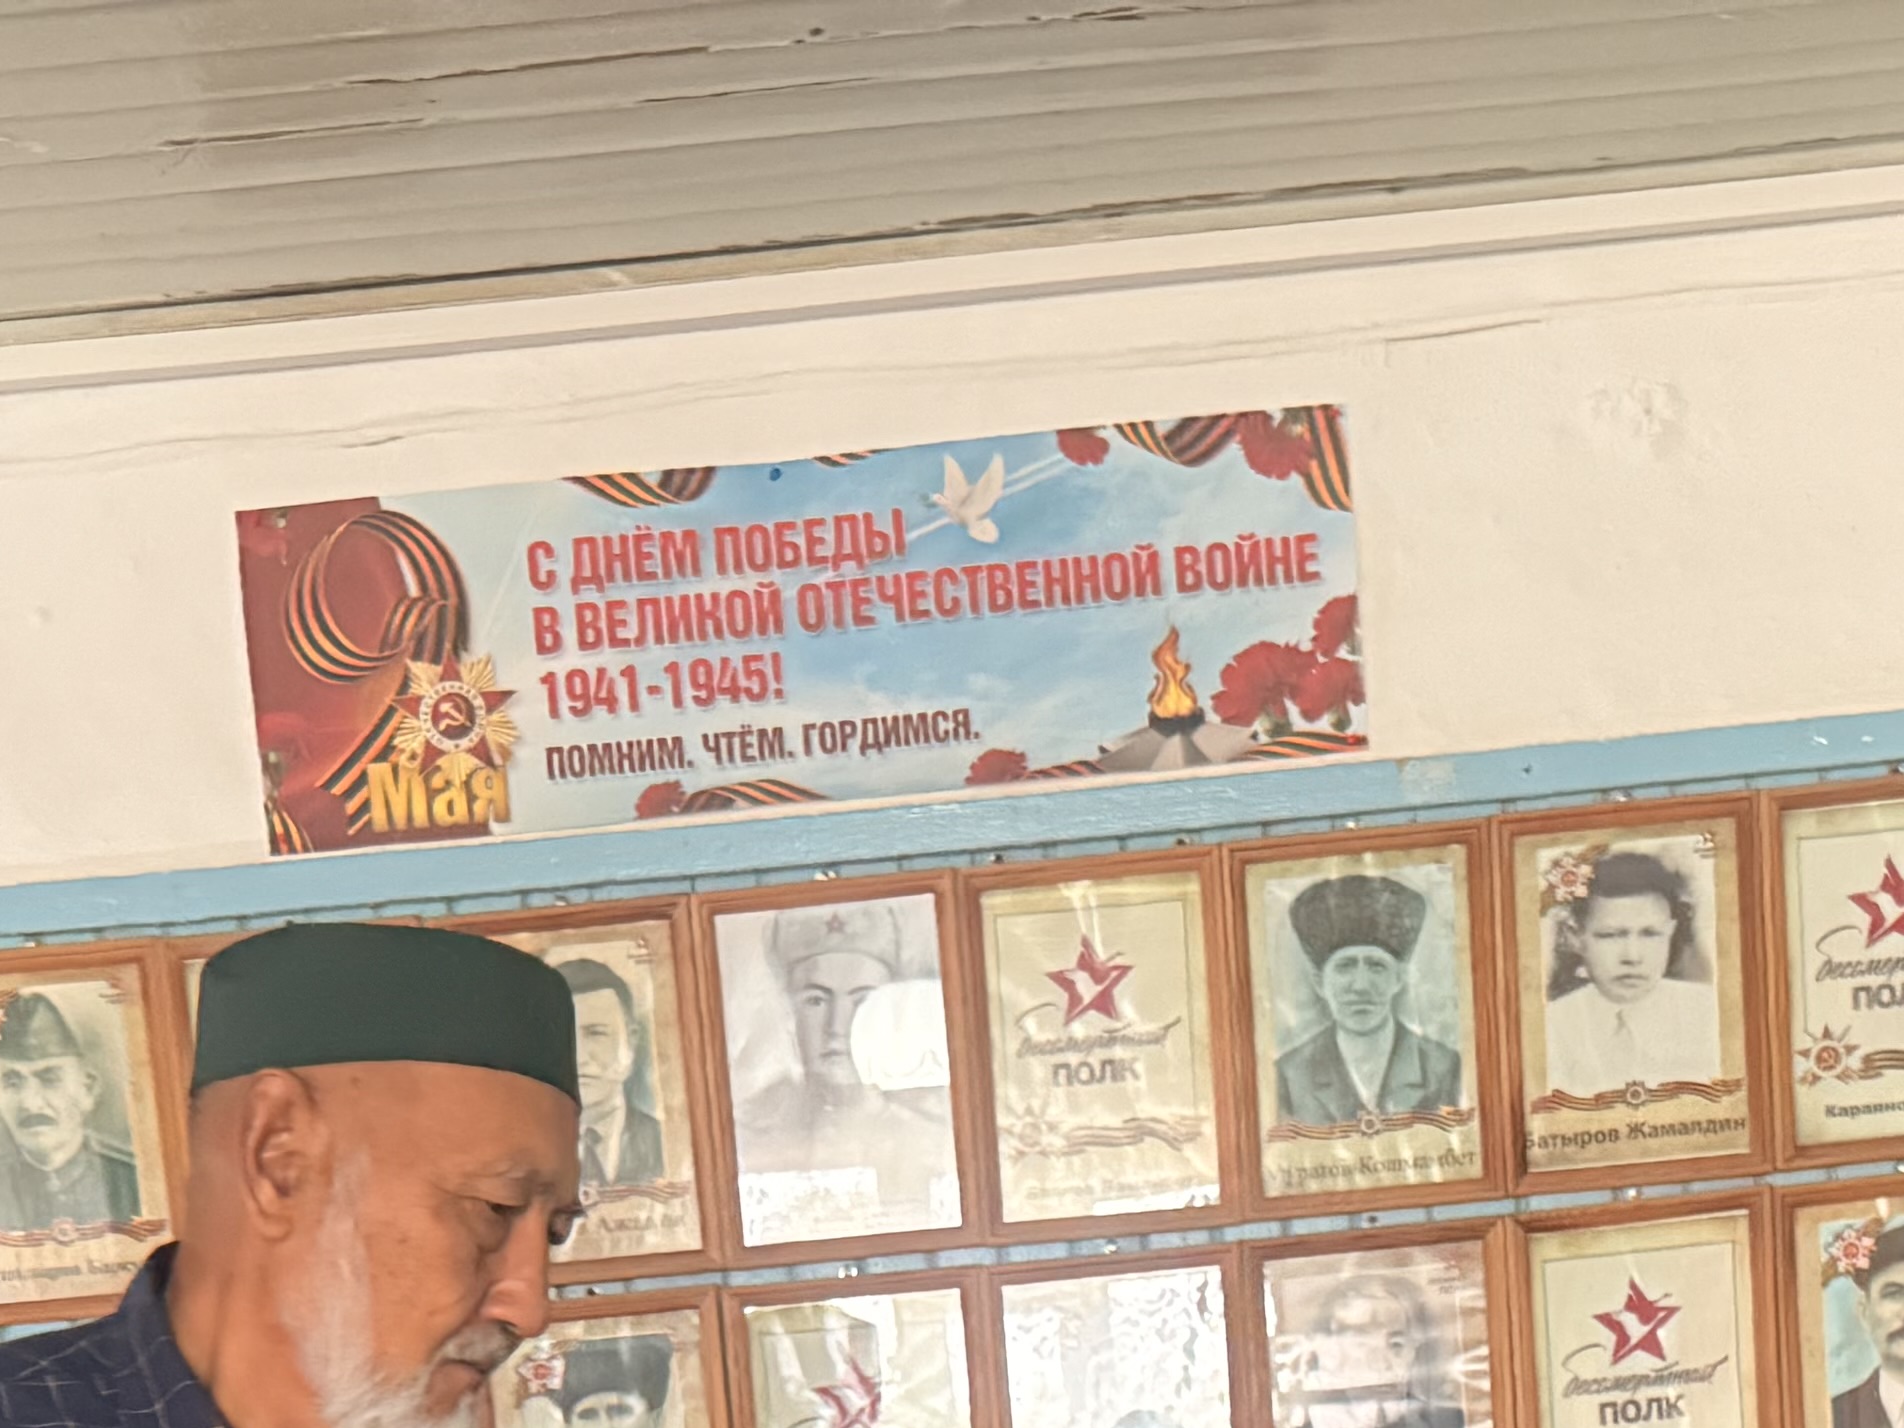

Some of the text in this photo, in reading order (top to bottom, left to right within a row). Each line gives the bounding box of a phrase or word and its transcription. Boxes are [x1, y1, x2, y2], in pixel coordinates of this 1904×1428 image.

[527, 508, 907, 594] С ДНЁМ ПОБЕДЫ
[533, 532, 1321, 655] В ВЕЛИКОЙ ОТЕЧЕСТВЕННОЙ ВОЙНЕ
[539, 652, 784, 720] 1941-1945!
[546, 708, 981, 781] ПОМНИМ. ЧТЁМ. ГОРДИМСЯ.
[1599, 1394, 1685, 1426] ПОЛК
